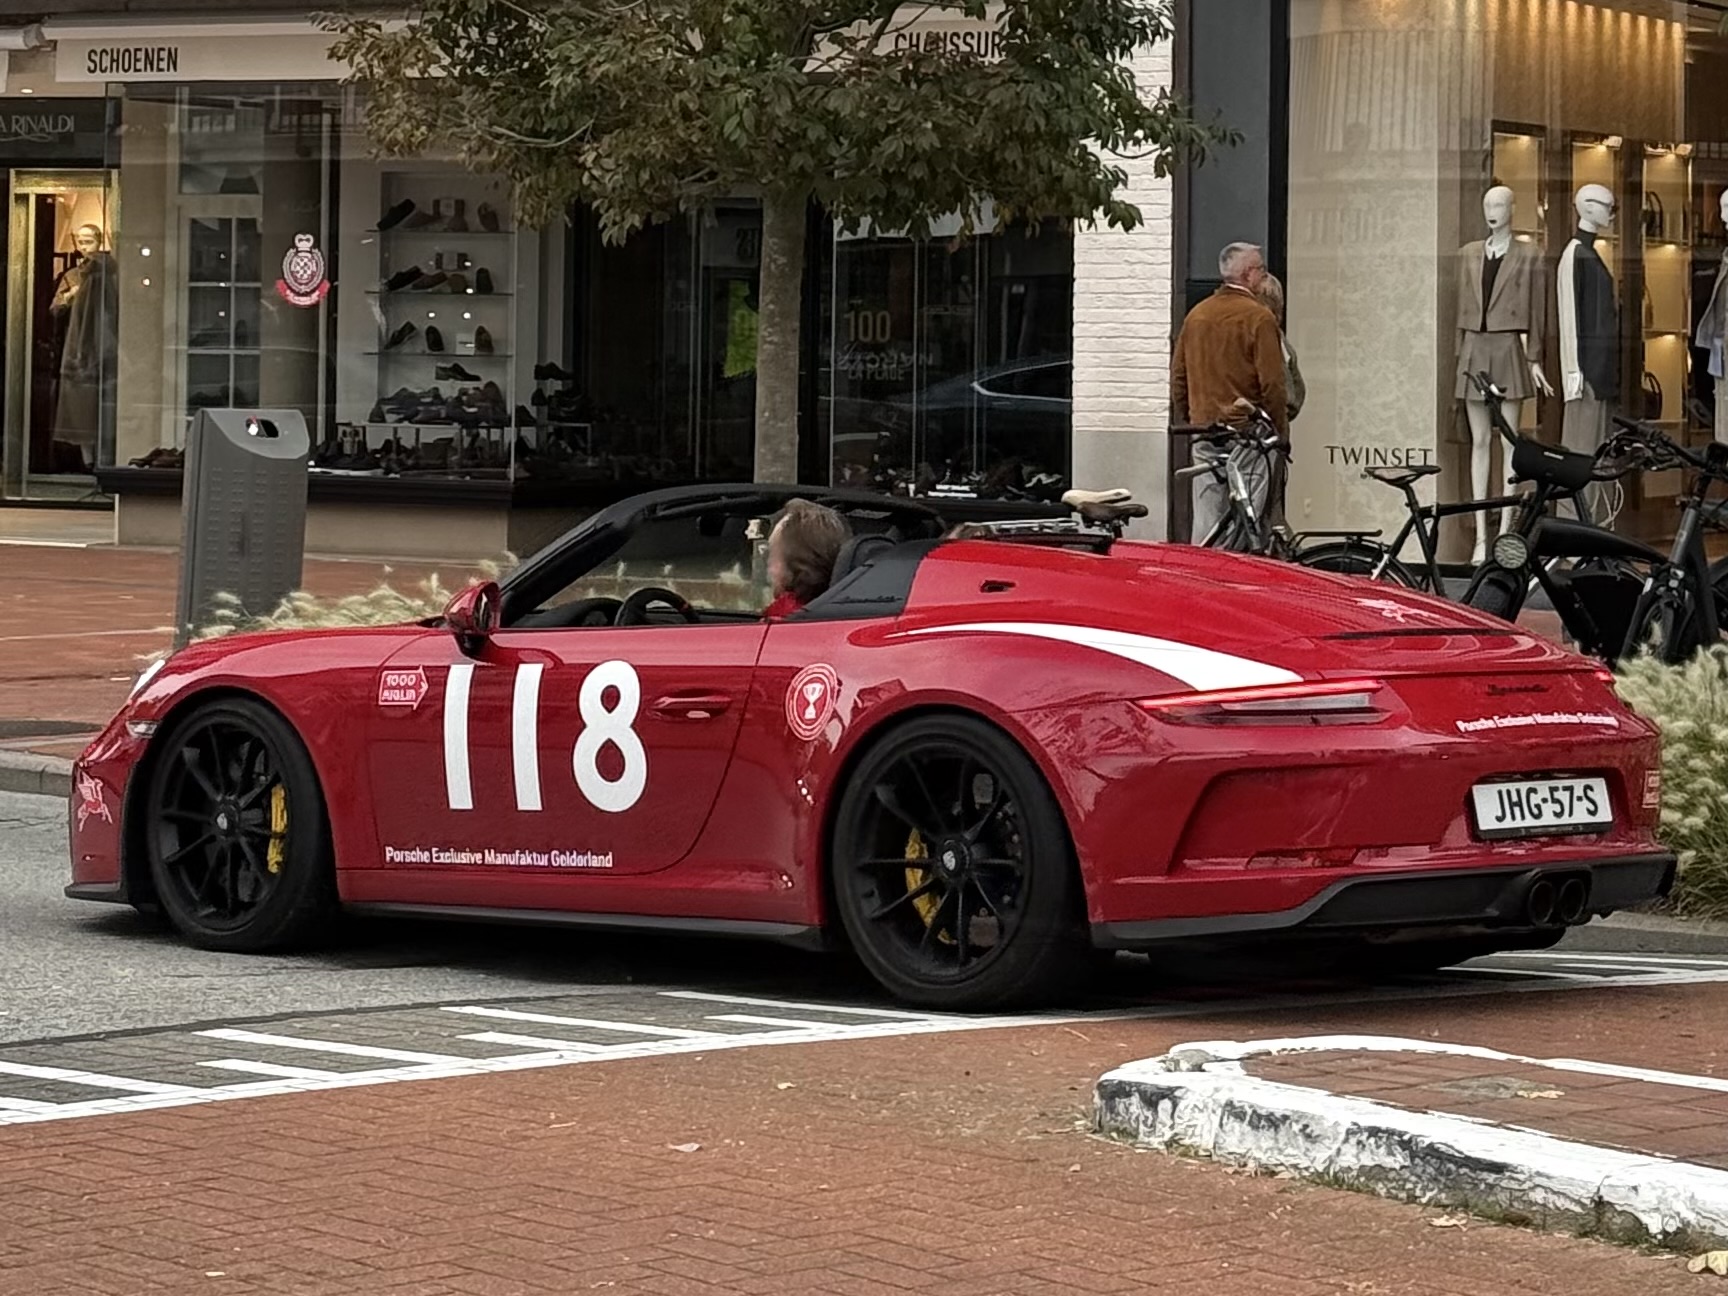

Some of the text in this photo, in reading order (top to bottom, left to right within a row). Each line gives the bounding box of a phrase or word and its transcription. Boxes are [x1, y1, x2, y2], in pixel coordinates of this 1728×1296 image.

[86, 46, 179, 74] SCHOENEN
[12, 114, 75, 134] RINALDI
[843, 309, 892, 344] 100
[1324, 445, 1433, 468] TWINSET
[386, 674, 417, 687] 1000
[444, 660, 647, 812] 118
[1494, 783, 1599, 823] JHG-57-S
[385, 846, 431, 863] Porsche
[431, 847, 483, 864] Exclusive
[484, 848, 550, 866] Manufaktur
